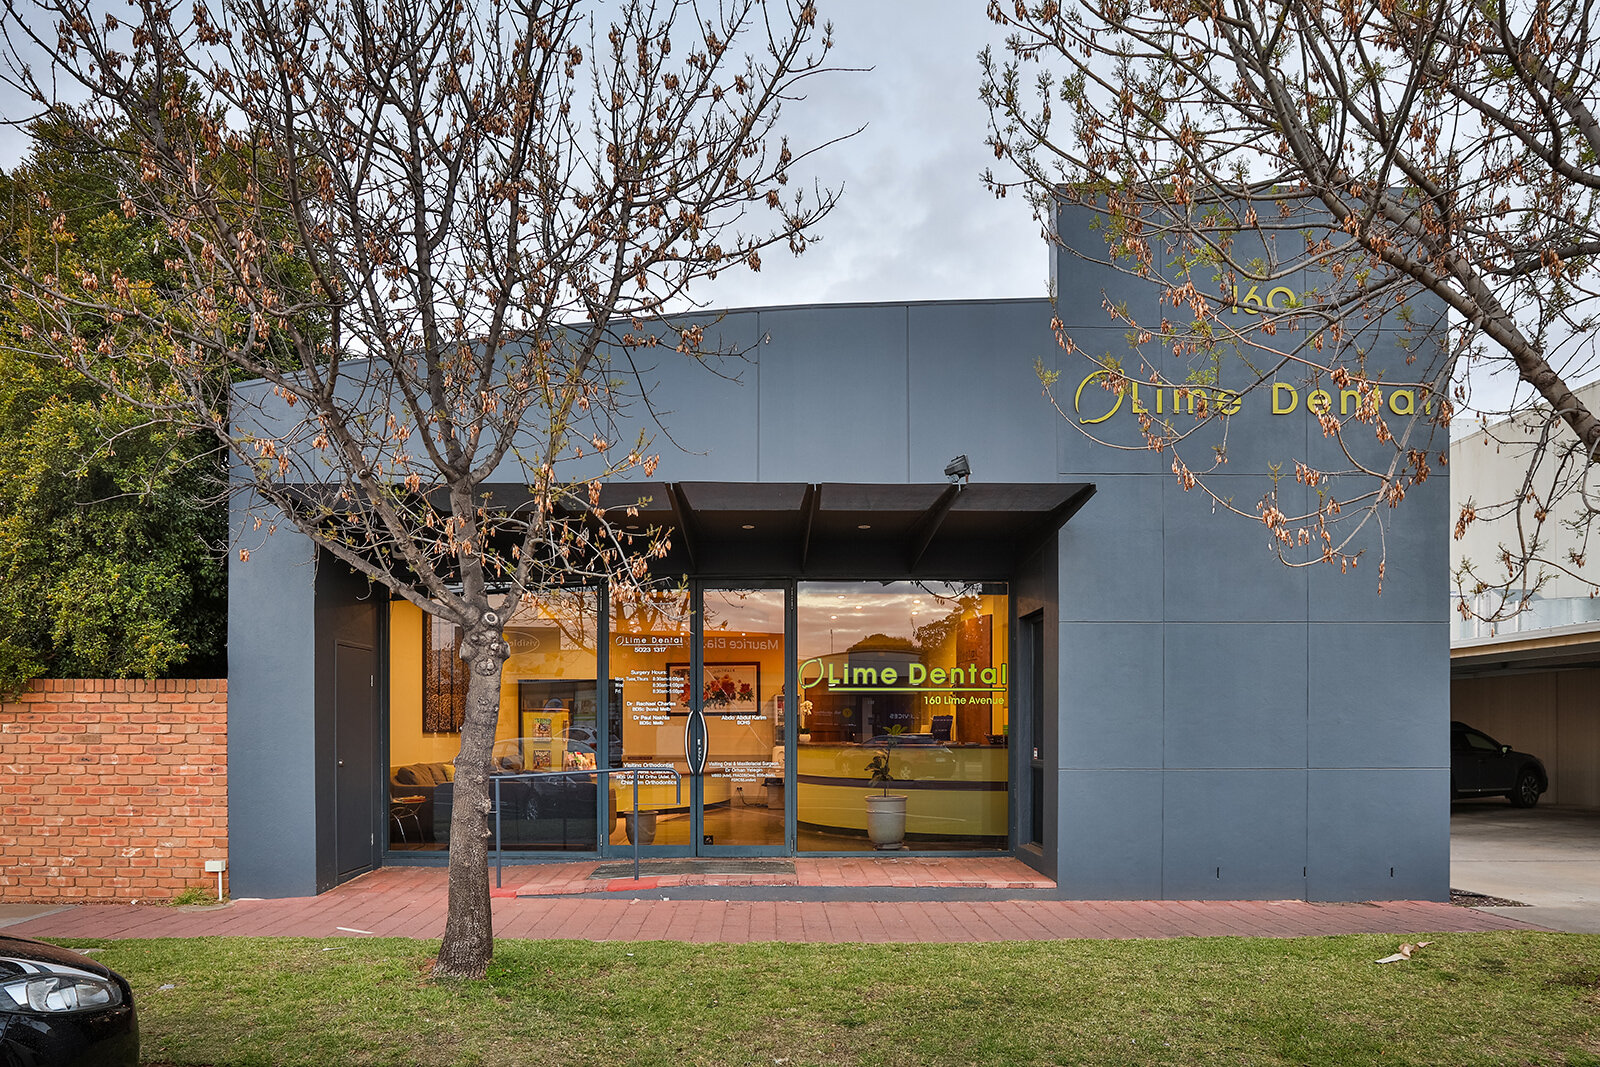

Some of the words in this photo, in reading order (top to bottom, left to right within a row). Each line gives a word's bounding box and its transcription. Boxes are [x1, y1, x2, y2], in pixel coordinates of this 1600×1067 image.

[1230, 285, 1296, 315] 160
[1131, 381, 1242, 415] Lime
[625, 636, 647, 644] Lime
[651, 636, 683, 644] Dental
[828, 663, 898, 685] Lime
[909, 662, 1007, 685] Dental
[924, 696, 941, 705] 160
[944, 696, 967, 705] Lime
[968, 696, 1005, 705] Avenue
